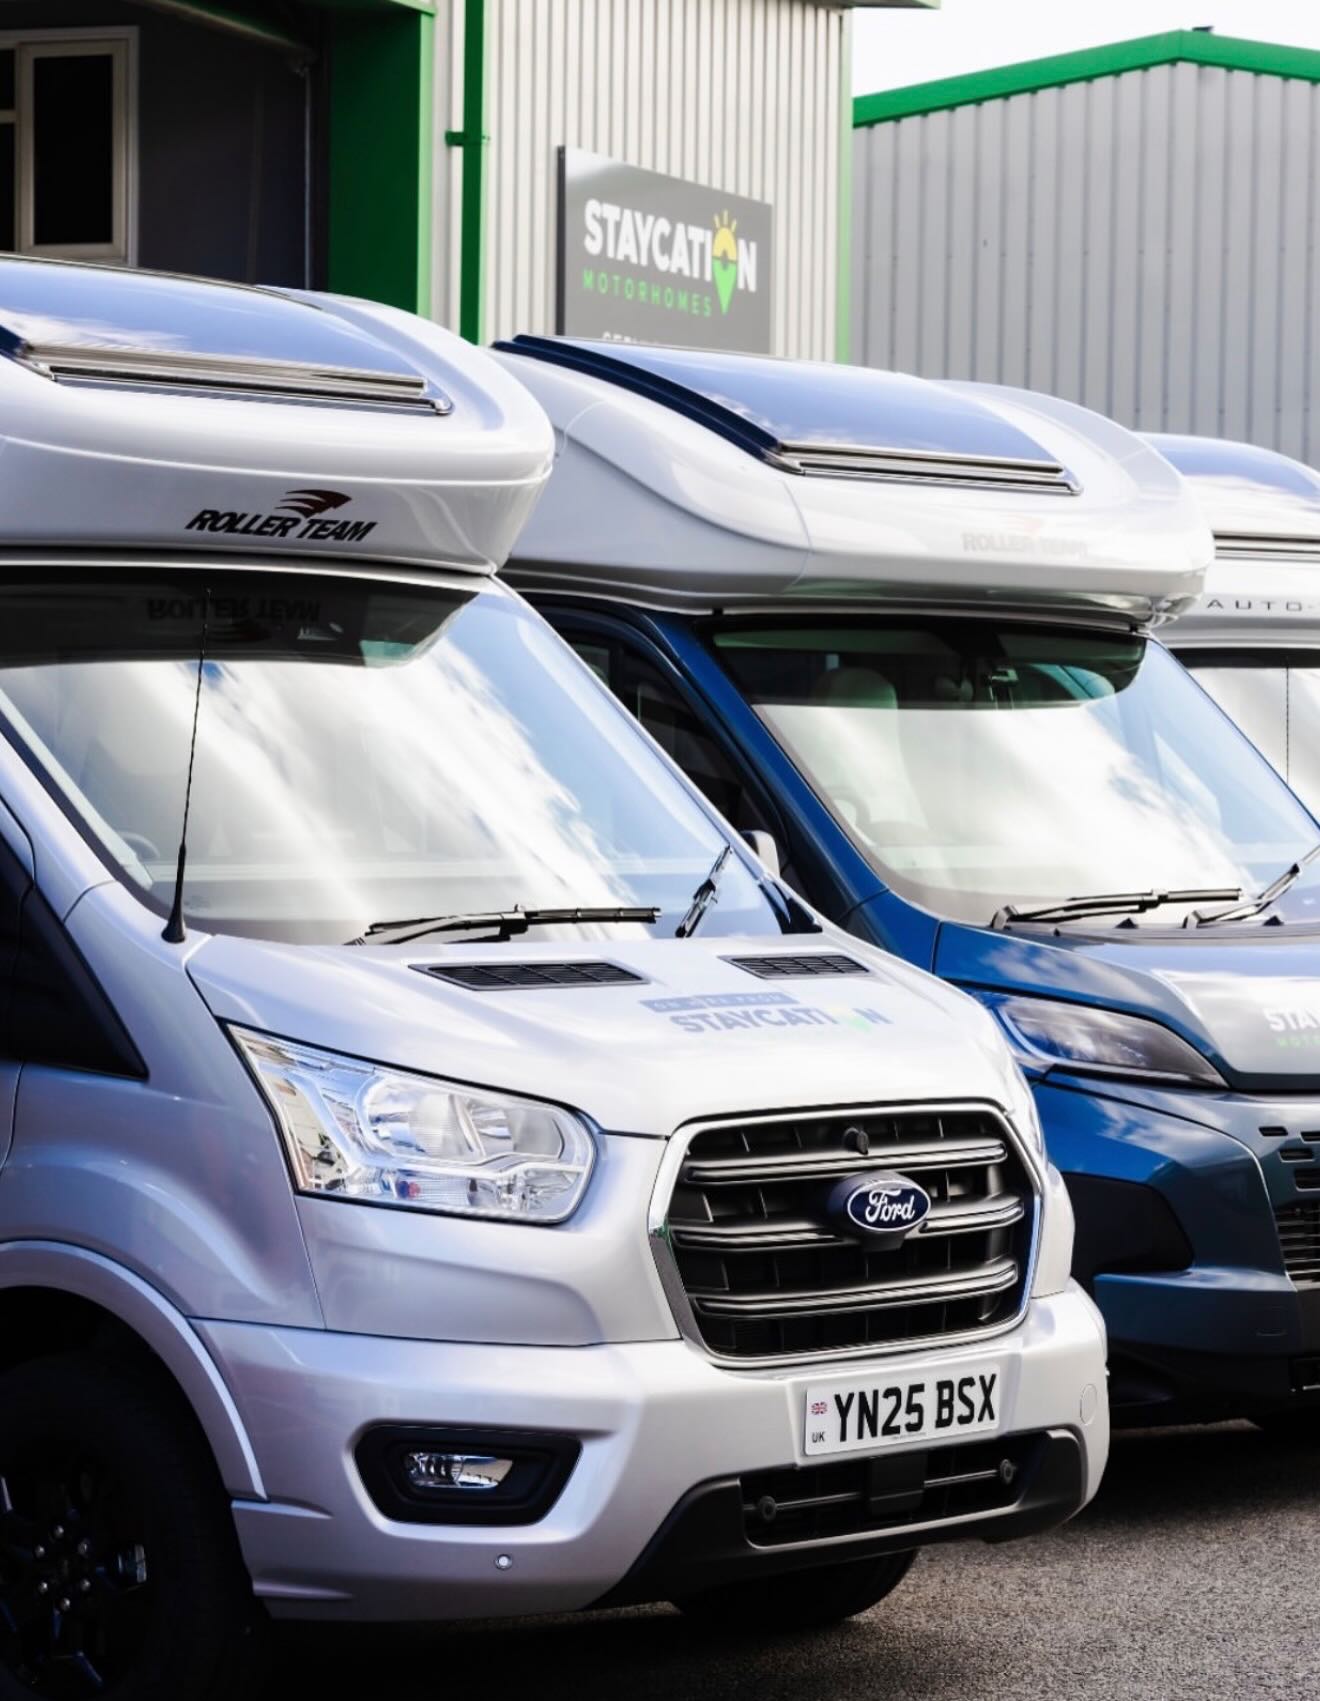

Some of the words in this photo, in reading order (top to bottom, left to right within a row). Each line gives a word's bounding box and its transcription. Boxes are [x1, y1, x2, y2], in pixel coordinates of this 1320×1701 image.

[583, 198, 758, 314] STAYCATION
[582, 266, 713, 318] MOTORHOMES
[184, 509, 302, 538] ROLLER
[296, 517, 378, 542] TEAM
[865, 1189, 916, 1223] Ford
[834, 1383, 926, 1442] YN25
[935, 1373, 997, 1429] BSX
[811, 1431, 826, 1443] UK
